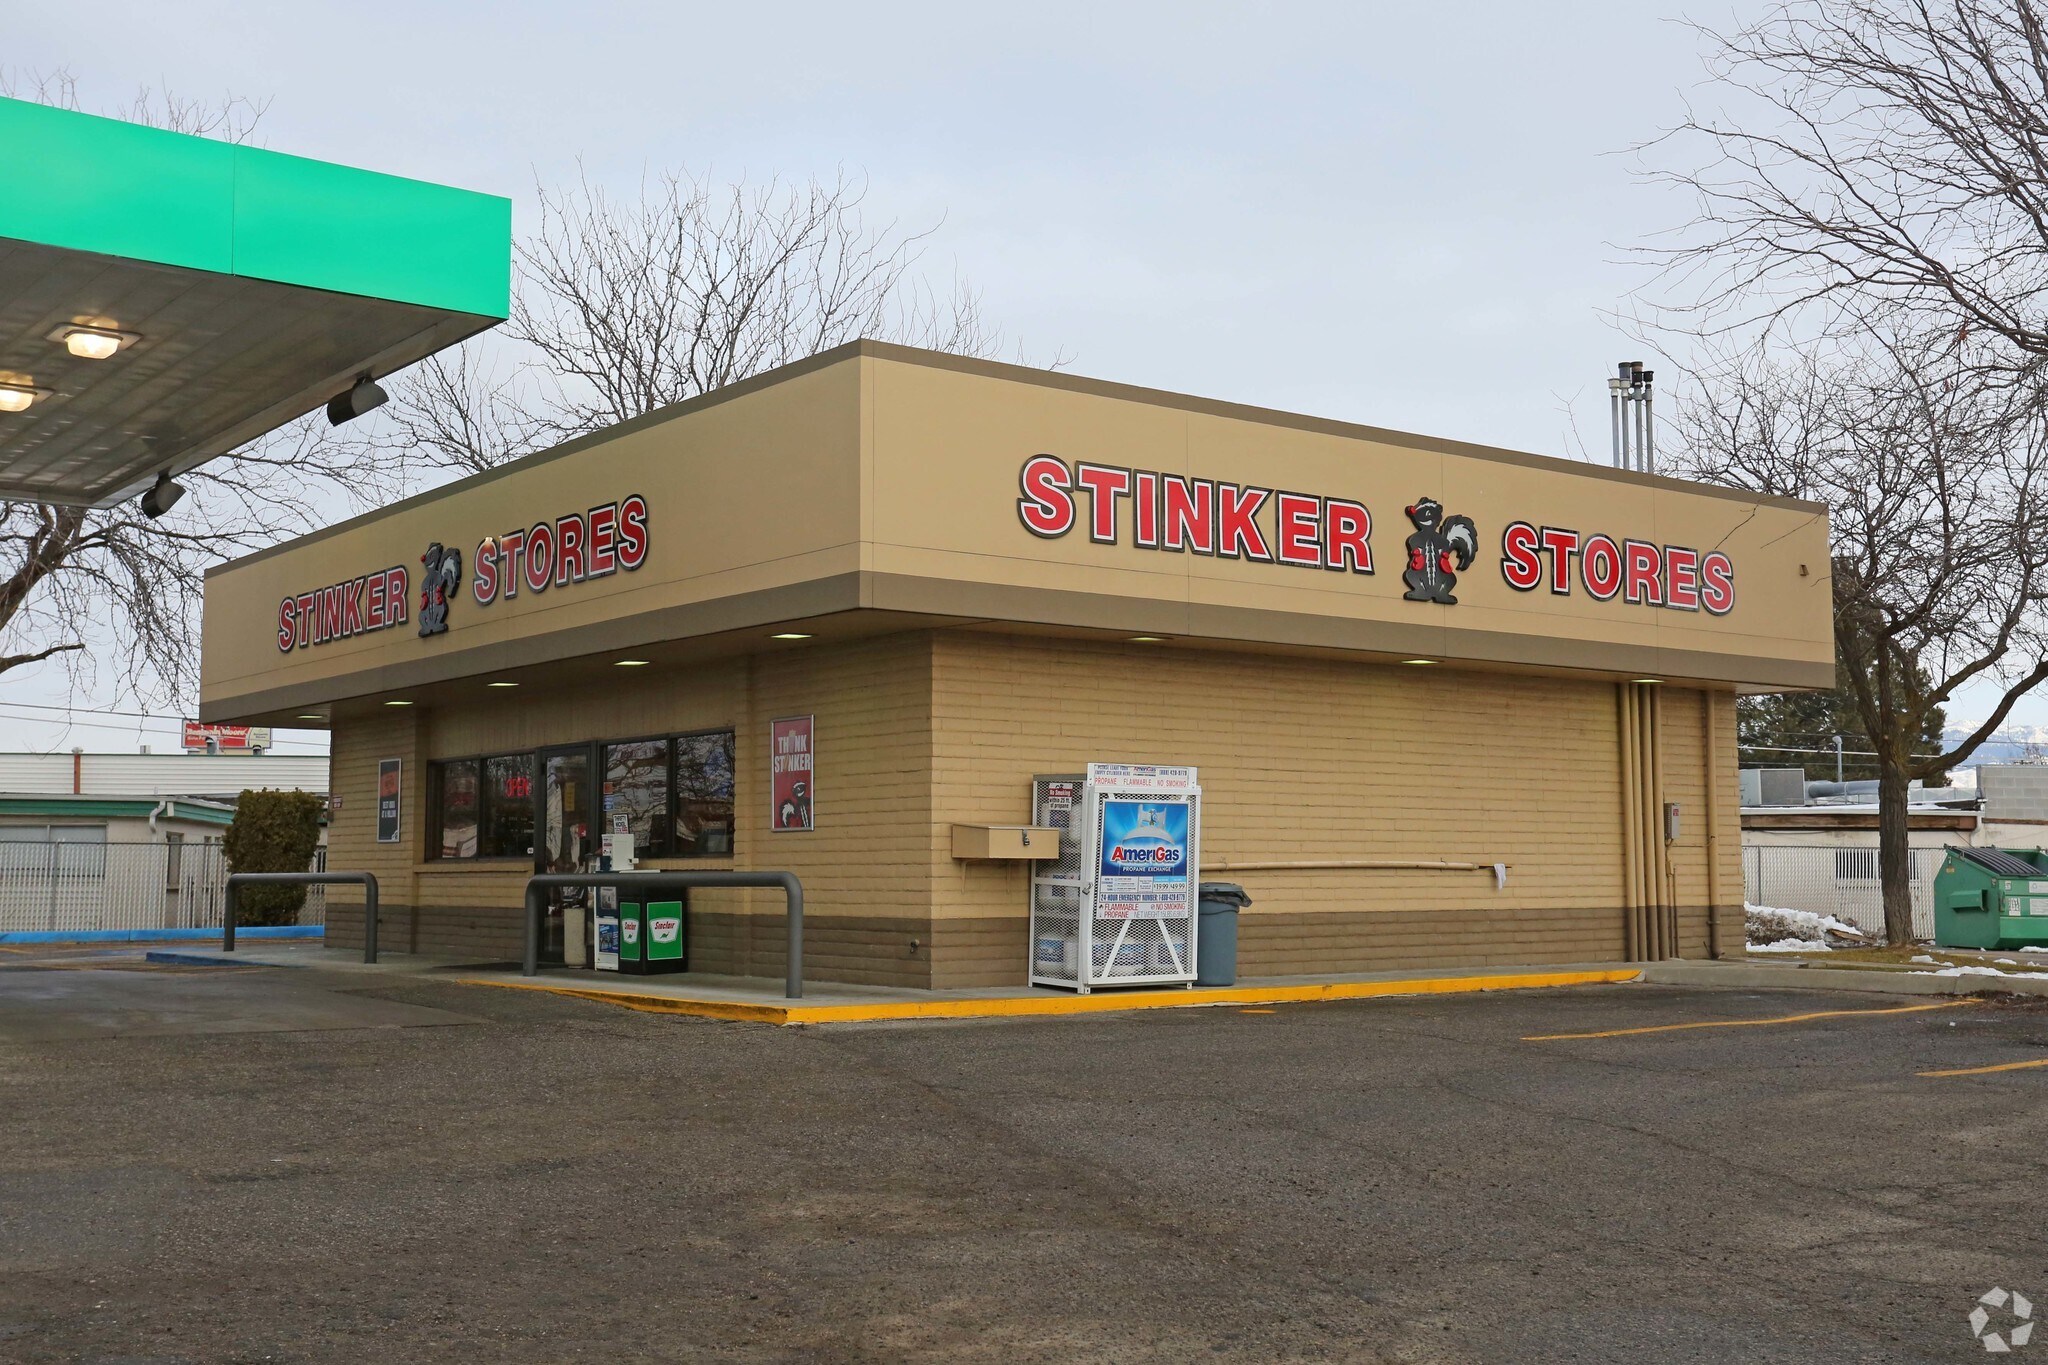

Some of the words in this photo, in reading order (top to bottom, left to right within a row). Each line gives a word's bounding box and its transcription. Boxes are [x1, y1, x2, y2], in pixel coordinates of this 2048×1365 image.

[1018, 454, 1374, 575] STINKER
[1501, 521, 1735, 616] STORES
[277, 565, 408, 652] STINKER
[473, 493, 648, 607] STORES
[774, 753, 811, 773] STINKER
[506, 776, 530, 797] OPEN
[1095, 777, 1117, 785] PROPANE
[1166, 780, 1186, 788] SMOKING
[1111, 846, 1180, 863] AmeriGas
[1104, 903, 1139, 911] FLAMMABLE
[624, 921, 637, 931] Sinclair
[654, 921, 676, 930] Sinclair
